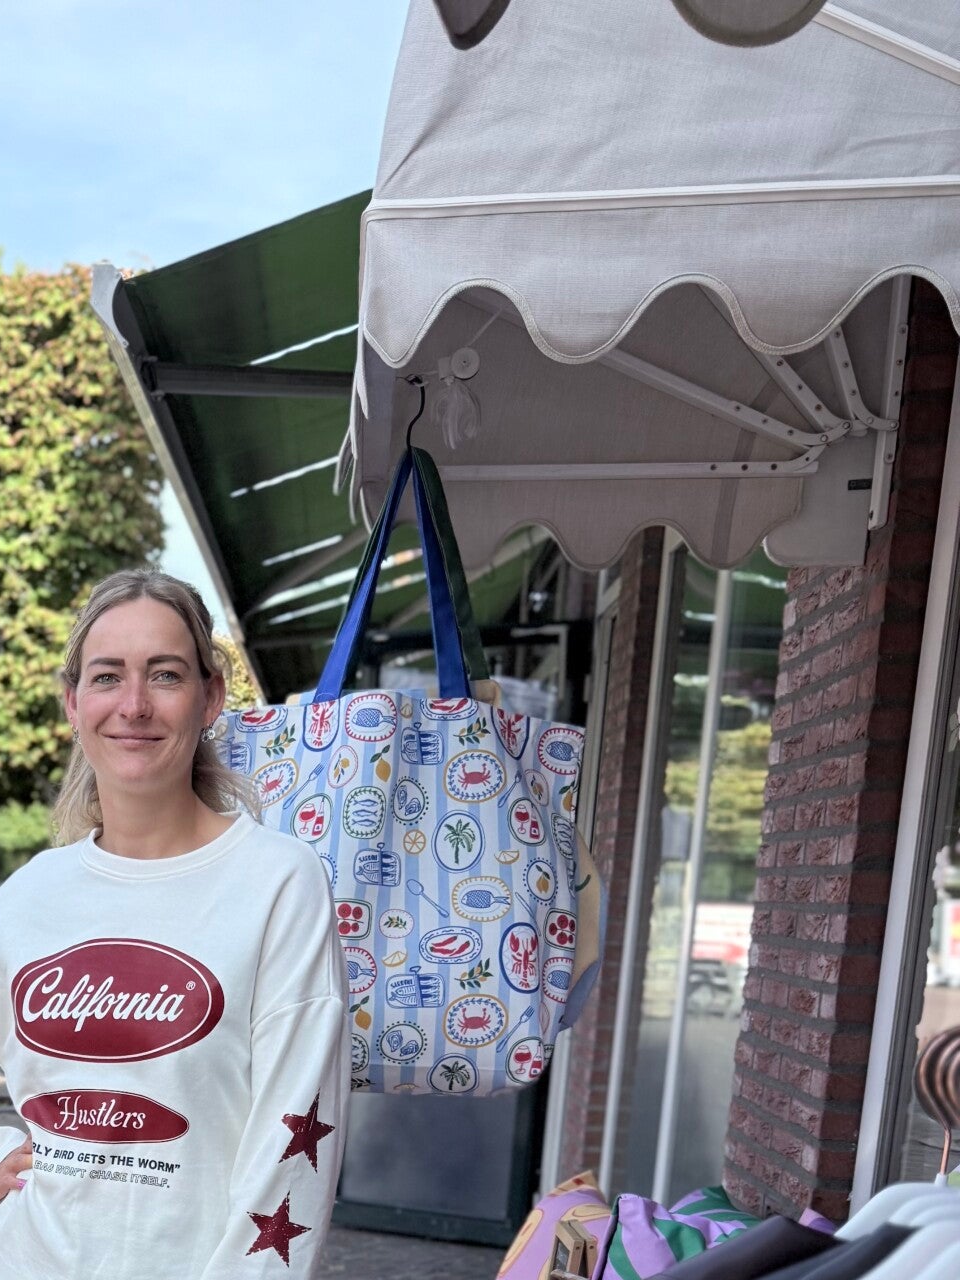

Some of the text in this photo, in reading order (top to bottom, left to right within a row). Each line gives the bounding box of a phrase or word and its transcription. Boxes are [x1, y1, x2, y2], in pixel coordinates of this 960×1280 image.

[54, 1094, 146, 1130] Hustlers
[53, 1149, 74, 1161] BIRD
[77, 1153, 106, 1165] GETS
[109, 1155, 134, 1167] THE
[89, 1169, 128, 1183] CHASE
